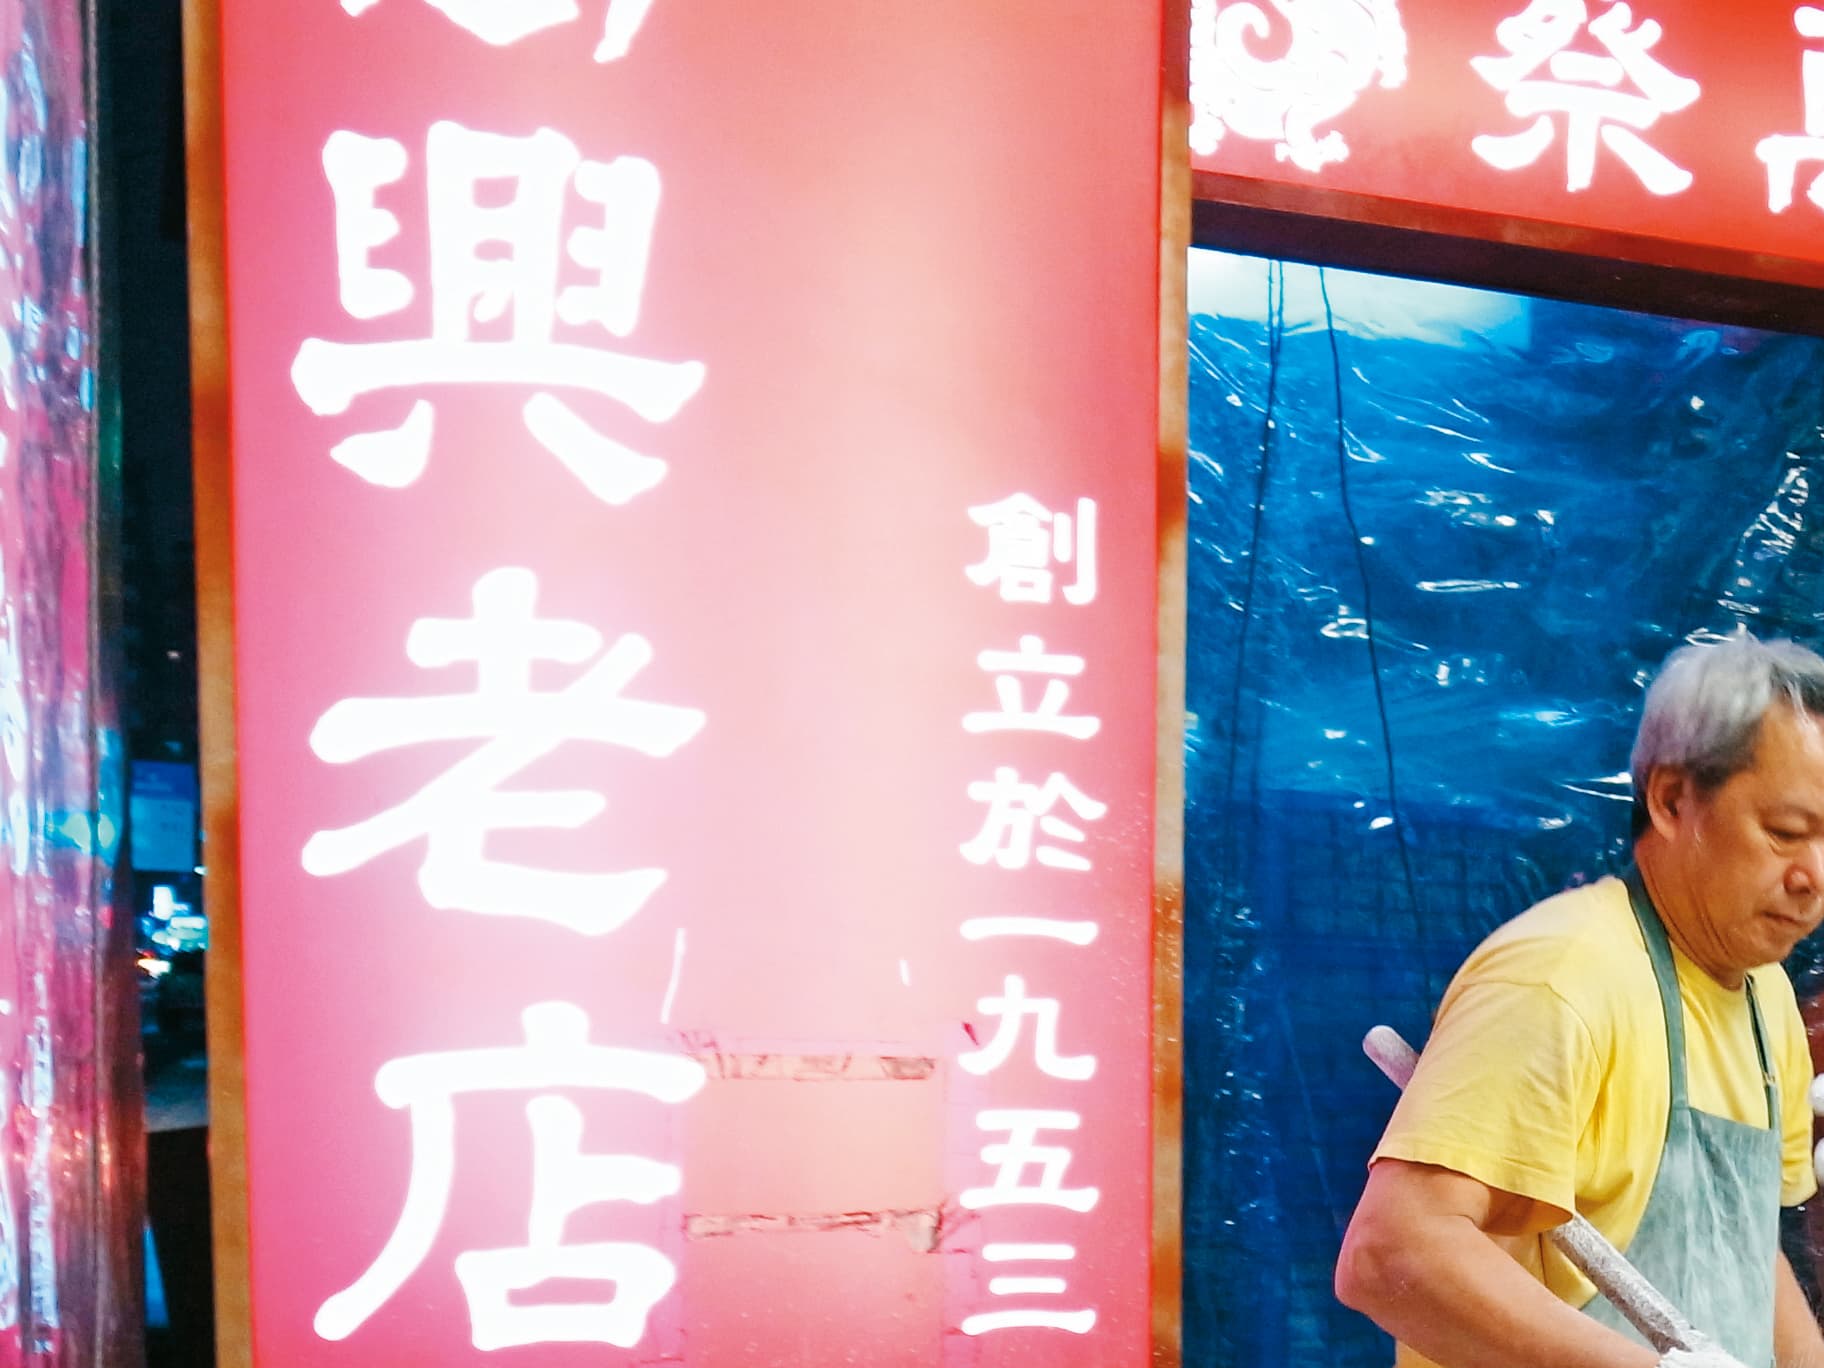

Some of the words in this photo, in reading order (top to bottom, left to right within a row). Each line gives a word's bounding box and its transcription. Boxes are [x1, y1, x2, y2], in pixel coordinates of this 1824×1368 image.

[292, 0, 704, 1351] 興老店
[958, 490, 1108, 1337] 創立於一九五三
